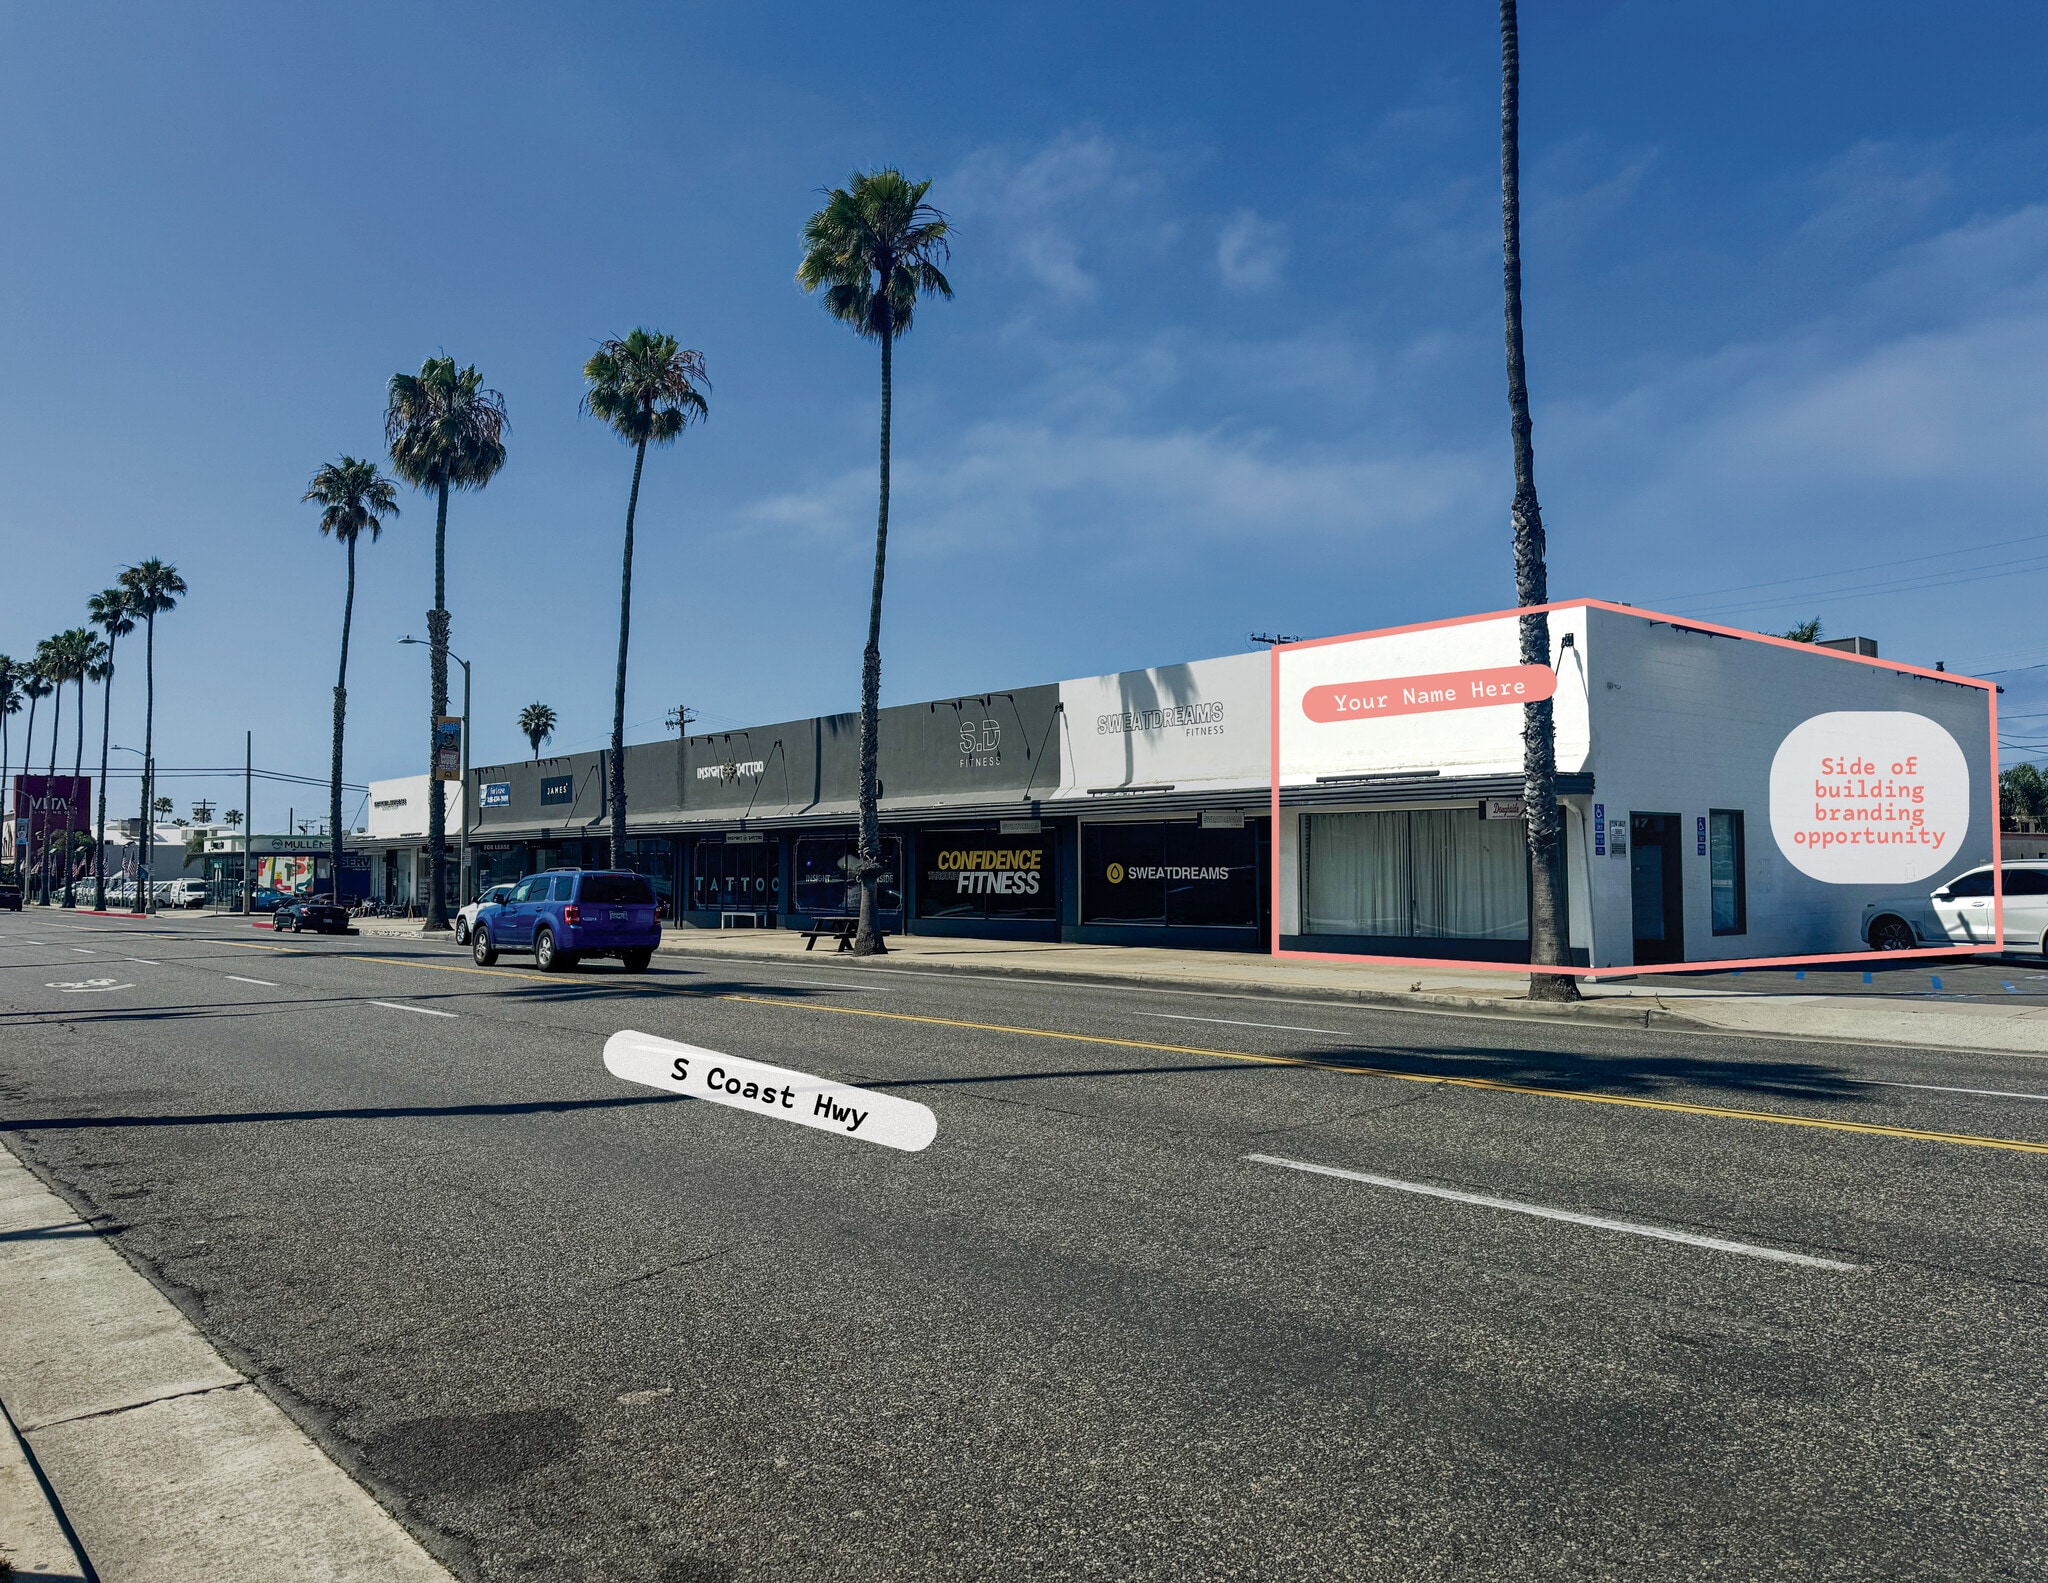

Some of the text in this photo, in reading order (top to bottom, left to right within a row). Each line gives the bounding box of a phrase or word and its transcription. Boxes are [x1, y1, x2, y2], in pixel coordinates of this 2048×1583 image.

[1097, 701, 1224, 735] SWEATDREAMS
[1186, 725, 1224, 736] FITNESS
[735, 761, 764, 778] TATTOO
[960, 757, 1001, 767] FITNESS
[938, 850, 1042, 870] CONFIDENCE
[1128, 866, 1229, 880] SWEATDREAMS
[696, 877, 779, 892] TATTOO
[957, 871, 1040, 894] FITNESS
